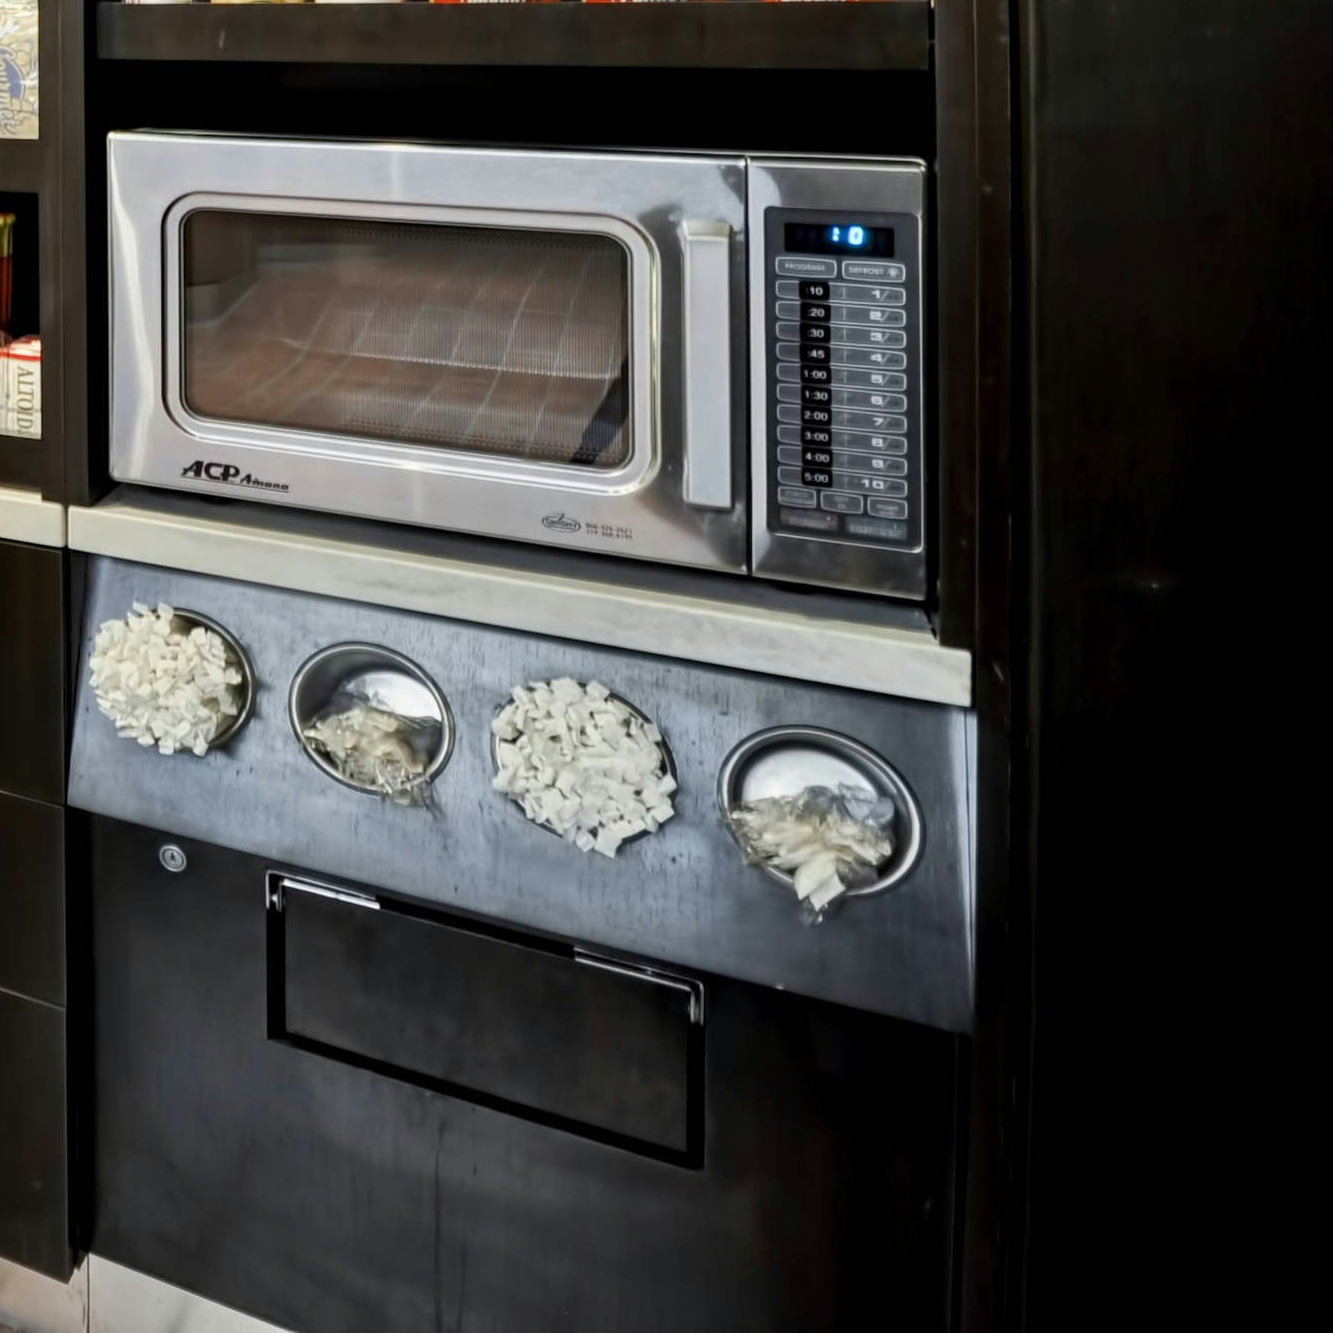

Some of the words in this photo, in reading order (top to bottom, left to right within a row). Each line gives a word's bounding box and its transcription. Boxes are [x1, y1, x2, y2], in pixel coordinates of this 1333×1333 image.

[803, 370, 828, 380] 1:00
[16, 365, 36, 434] ALTOID
[804, 391, 829, 401] 1:30
[803, 411, 829, 422] 2:00
[804, 432, 829, 442] 3:00
[804, 452, 830, 462] 4:00
[181, 460, 241, 483] ACP
[240, 473, 291, 491] Amana
[804, 473, 829, 484] 5:00
